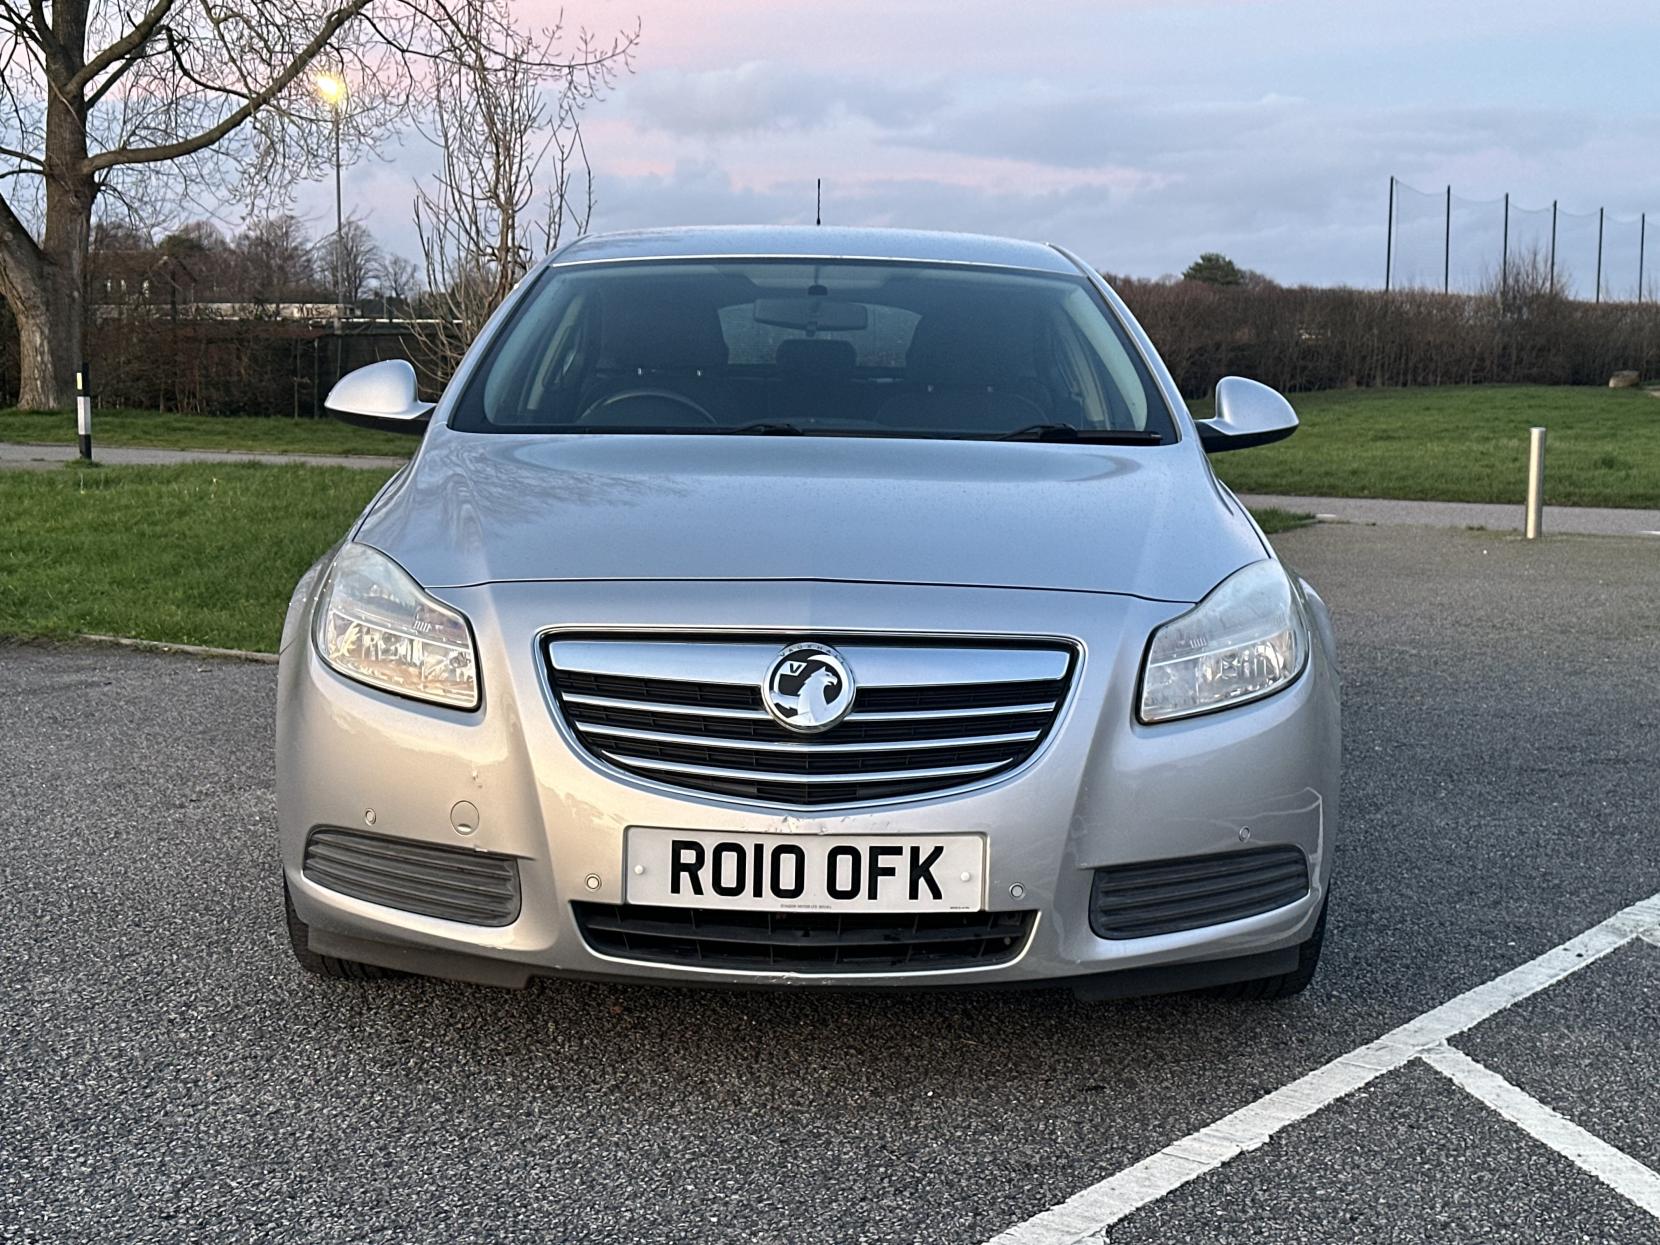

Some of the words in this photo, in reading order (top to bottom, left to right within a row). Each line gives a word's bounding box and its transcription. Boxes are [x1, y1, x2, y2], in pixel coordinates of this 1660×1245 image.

[790, 663, 803, 674] V
[670, 839, 806, 900] RO10
[826, 845, 945, 901] OFK
